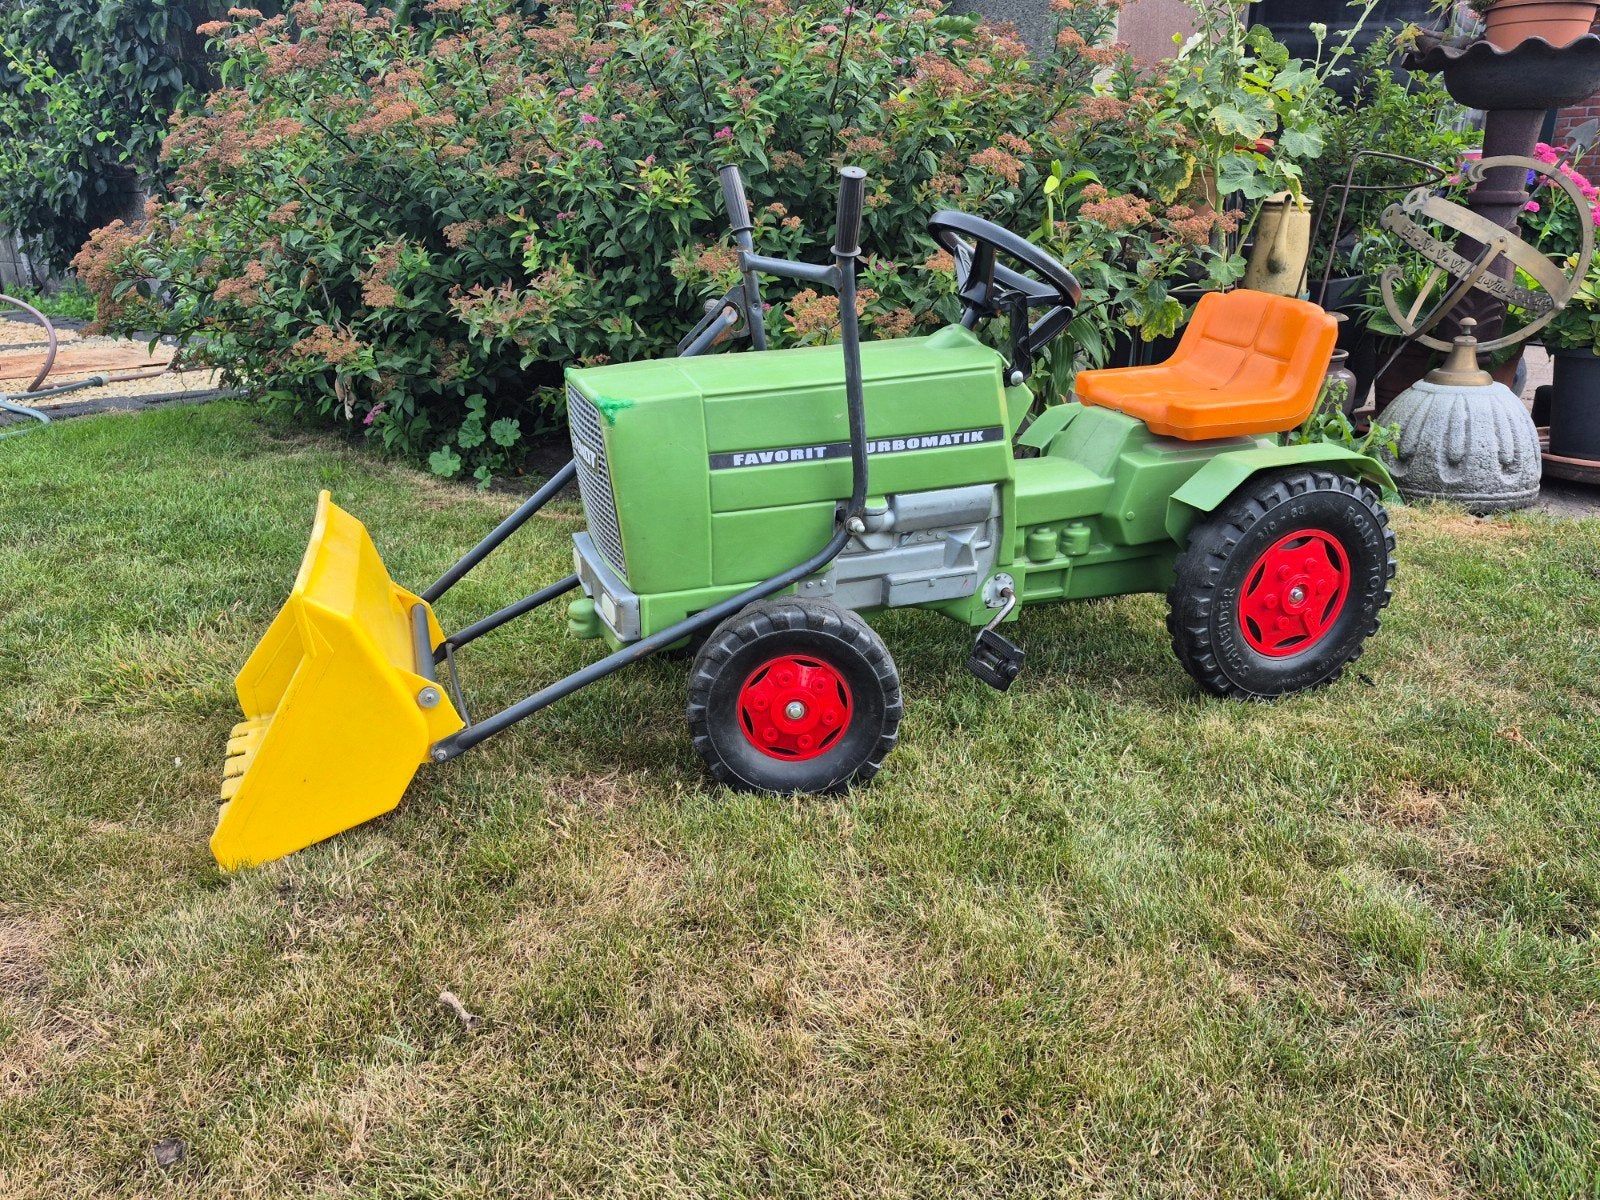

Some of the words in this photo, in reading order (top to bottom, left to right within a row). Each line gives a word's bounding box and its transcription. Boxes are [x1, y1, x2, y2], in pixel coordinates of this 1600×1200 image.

[733, 446, 827, 466] FAVORIT
[866, 430, 984, 454] URBOMATIK
[1218, 587, 1250, 677] SCHNEIDER
